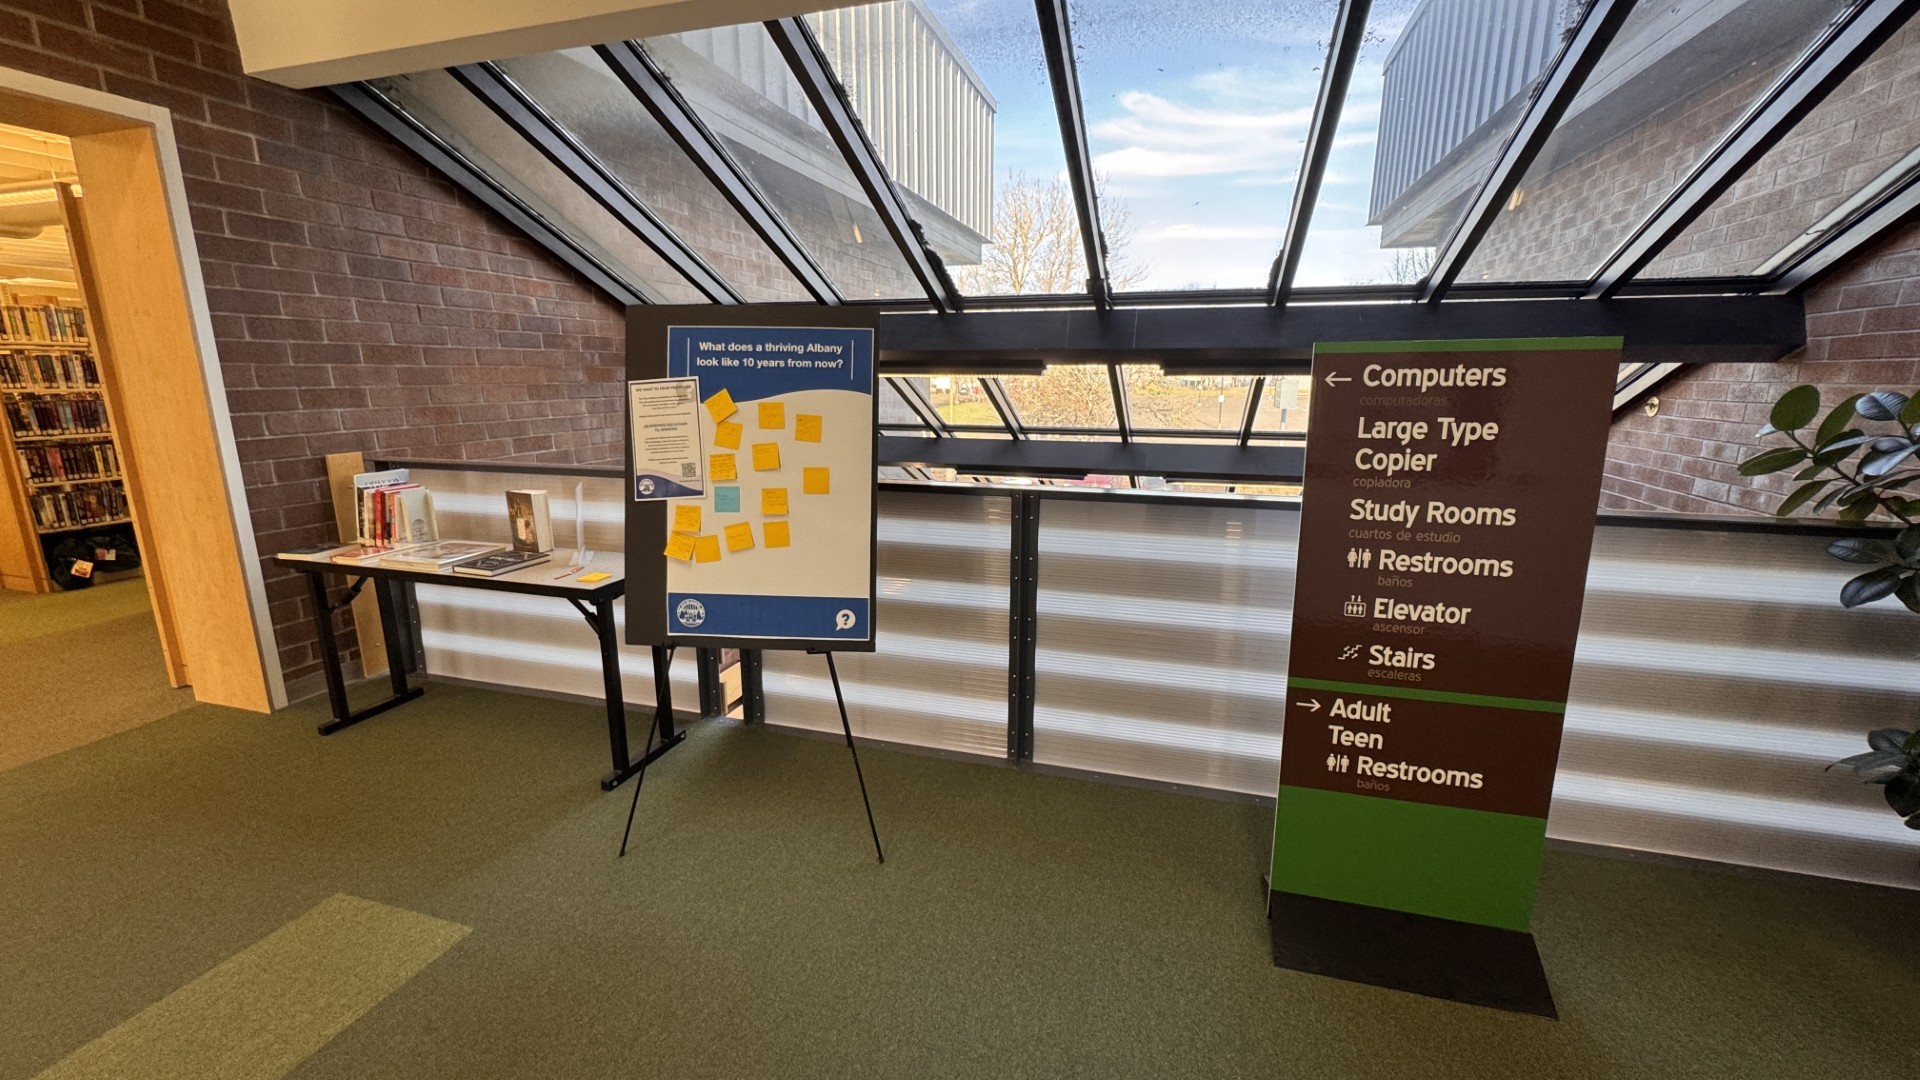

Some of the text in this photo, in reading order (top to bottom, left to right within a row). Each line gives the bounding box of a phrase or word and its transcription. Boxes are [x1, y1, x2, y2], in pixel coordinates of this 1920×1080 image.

[699, 342, 725, 351] What
[728, 342, 753, 351] does
[765, 343, 804, 354] thriving
[806, 343, 843, 355] Albany
[697, 357, 843, 369] look like 10 years from now?
[1363, 363, 1507, 393] Computers
[1359, 395, 1448, 408] computadoras
[1358, 417, 1499, 447] Large Type
[1355, 448, 1438, 477] Copier
[1353, 475, 1411, 489] copiadora
[1350, 498, 1517, 528] Study Rooms
[1349, 528, 1461, 543] cuartos de estudio
[1379, 549, 1514, 578] Restrooms
[1377, 575, 1413, 588] baños
[1373, 597, 1472, 625] Elevator
[1373, 622, 1426, 635] ascensor
[1368, 644, 1436, 670] Stairs
[1367, 668, 1422, 682] escaleras
[1329, 698, 1392, 723] Adult
[1328, 725, 1384, 750] Teen
[1357, 755, 1484, 790] Restrooms
[1357, 778, 1391, 792] baños
